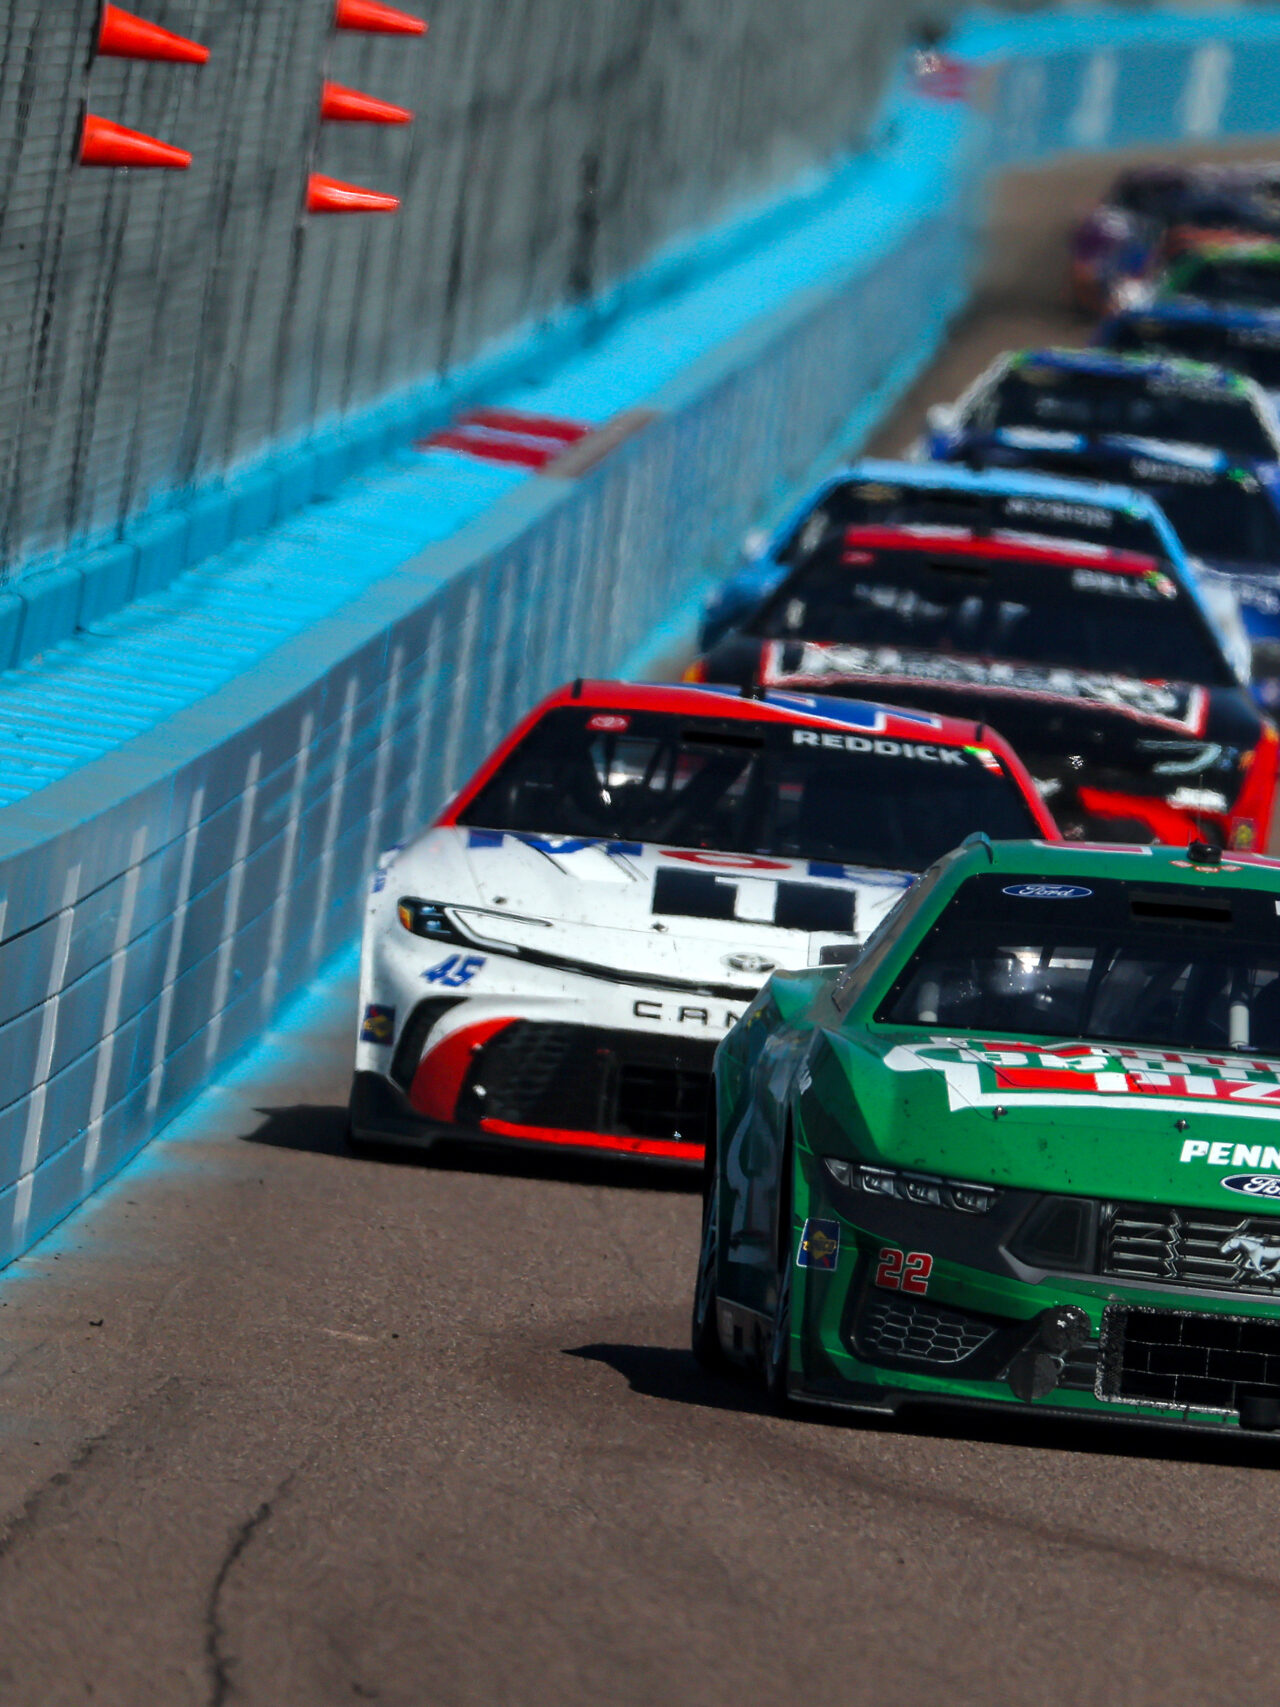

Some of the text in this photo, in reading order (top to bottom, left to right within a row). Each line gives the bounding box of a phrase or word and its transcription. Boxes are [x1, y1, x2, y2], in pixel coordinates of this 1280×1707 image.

[792, 729, 968, 766] REDDICK
[1018, 884, 1076, 897] Ford
[420, 954, 487, 987] 45
[875, 1247, 934, 1296] 22
